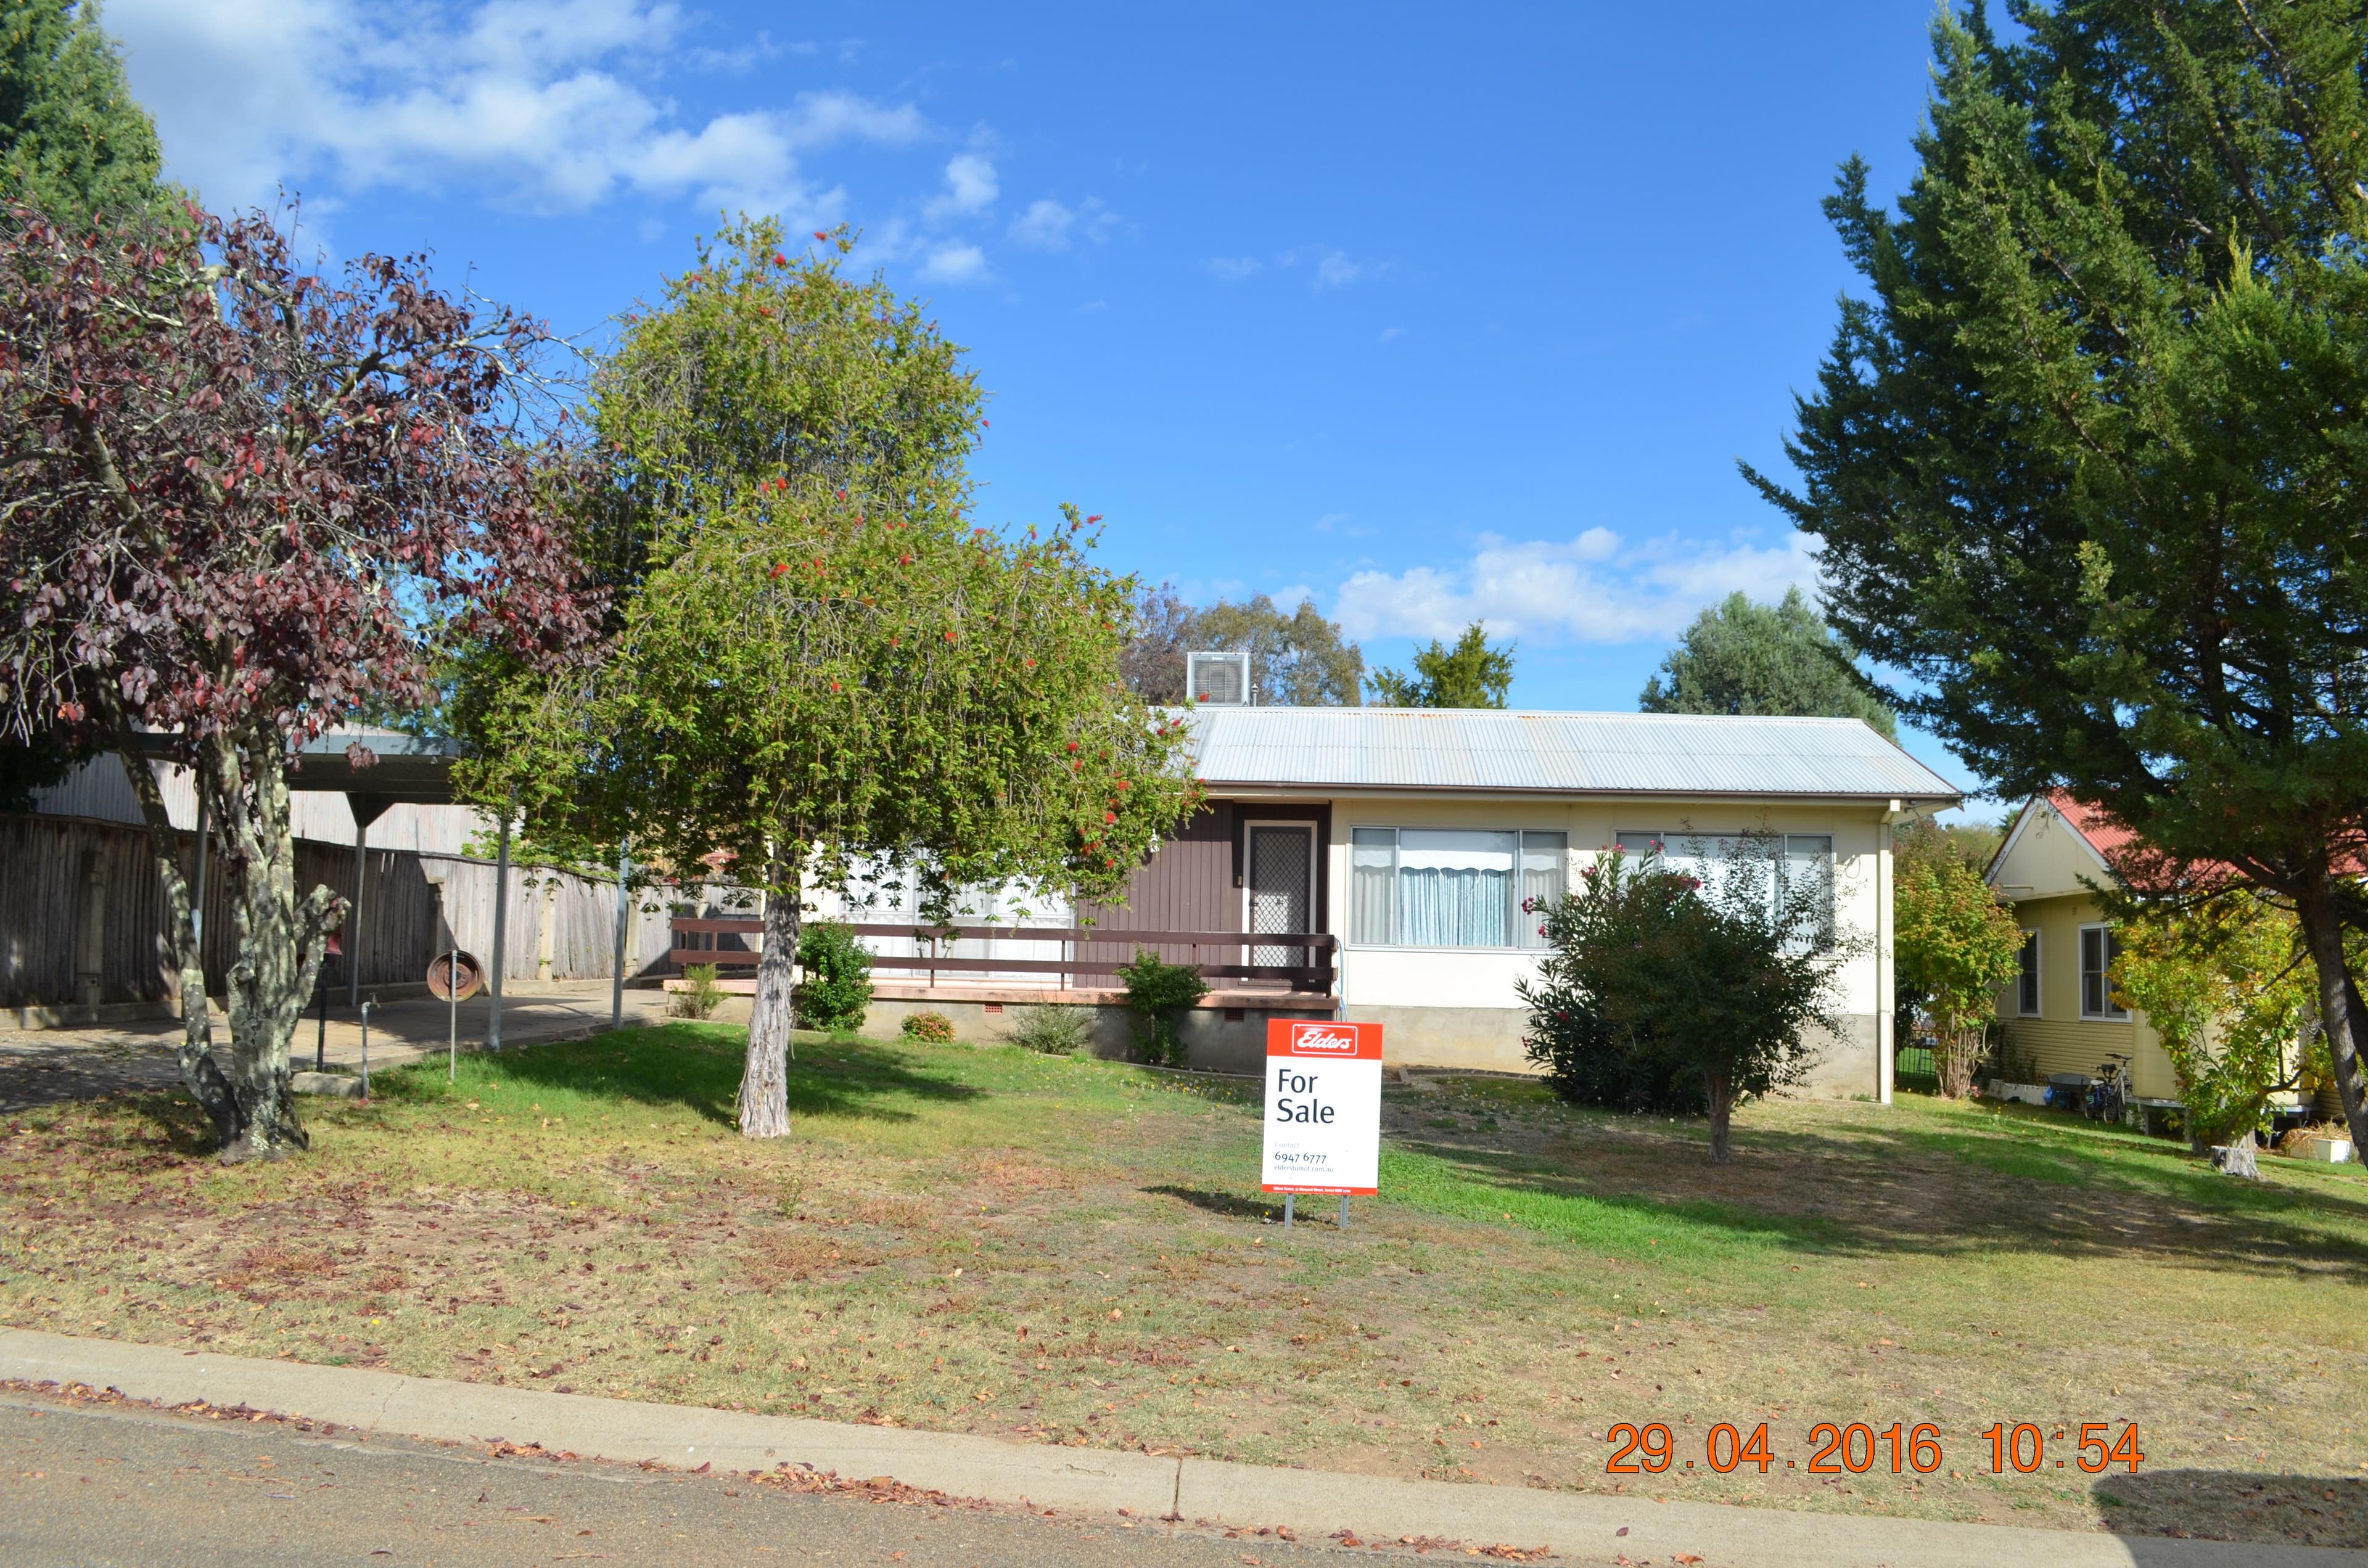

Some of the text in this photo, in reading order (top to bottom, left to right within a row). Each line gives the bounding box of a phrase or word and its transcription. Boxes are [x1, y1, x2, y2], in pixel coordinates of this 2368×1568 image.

[1297, 1030, 1352, 1049] Elders
[1278, 1069, 1318, 1093] For
[1276, 1098, 1334, 1124] Sale
[1275, 1151, 1327, 1164] 6947 6777
[1274, 1164, 1333, 1173] elderstumut.com.au
